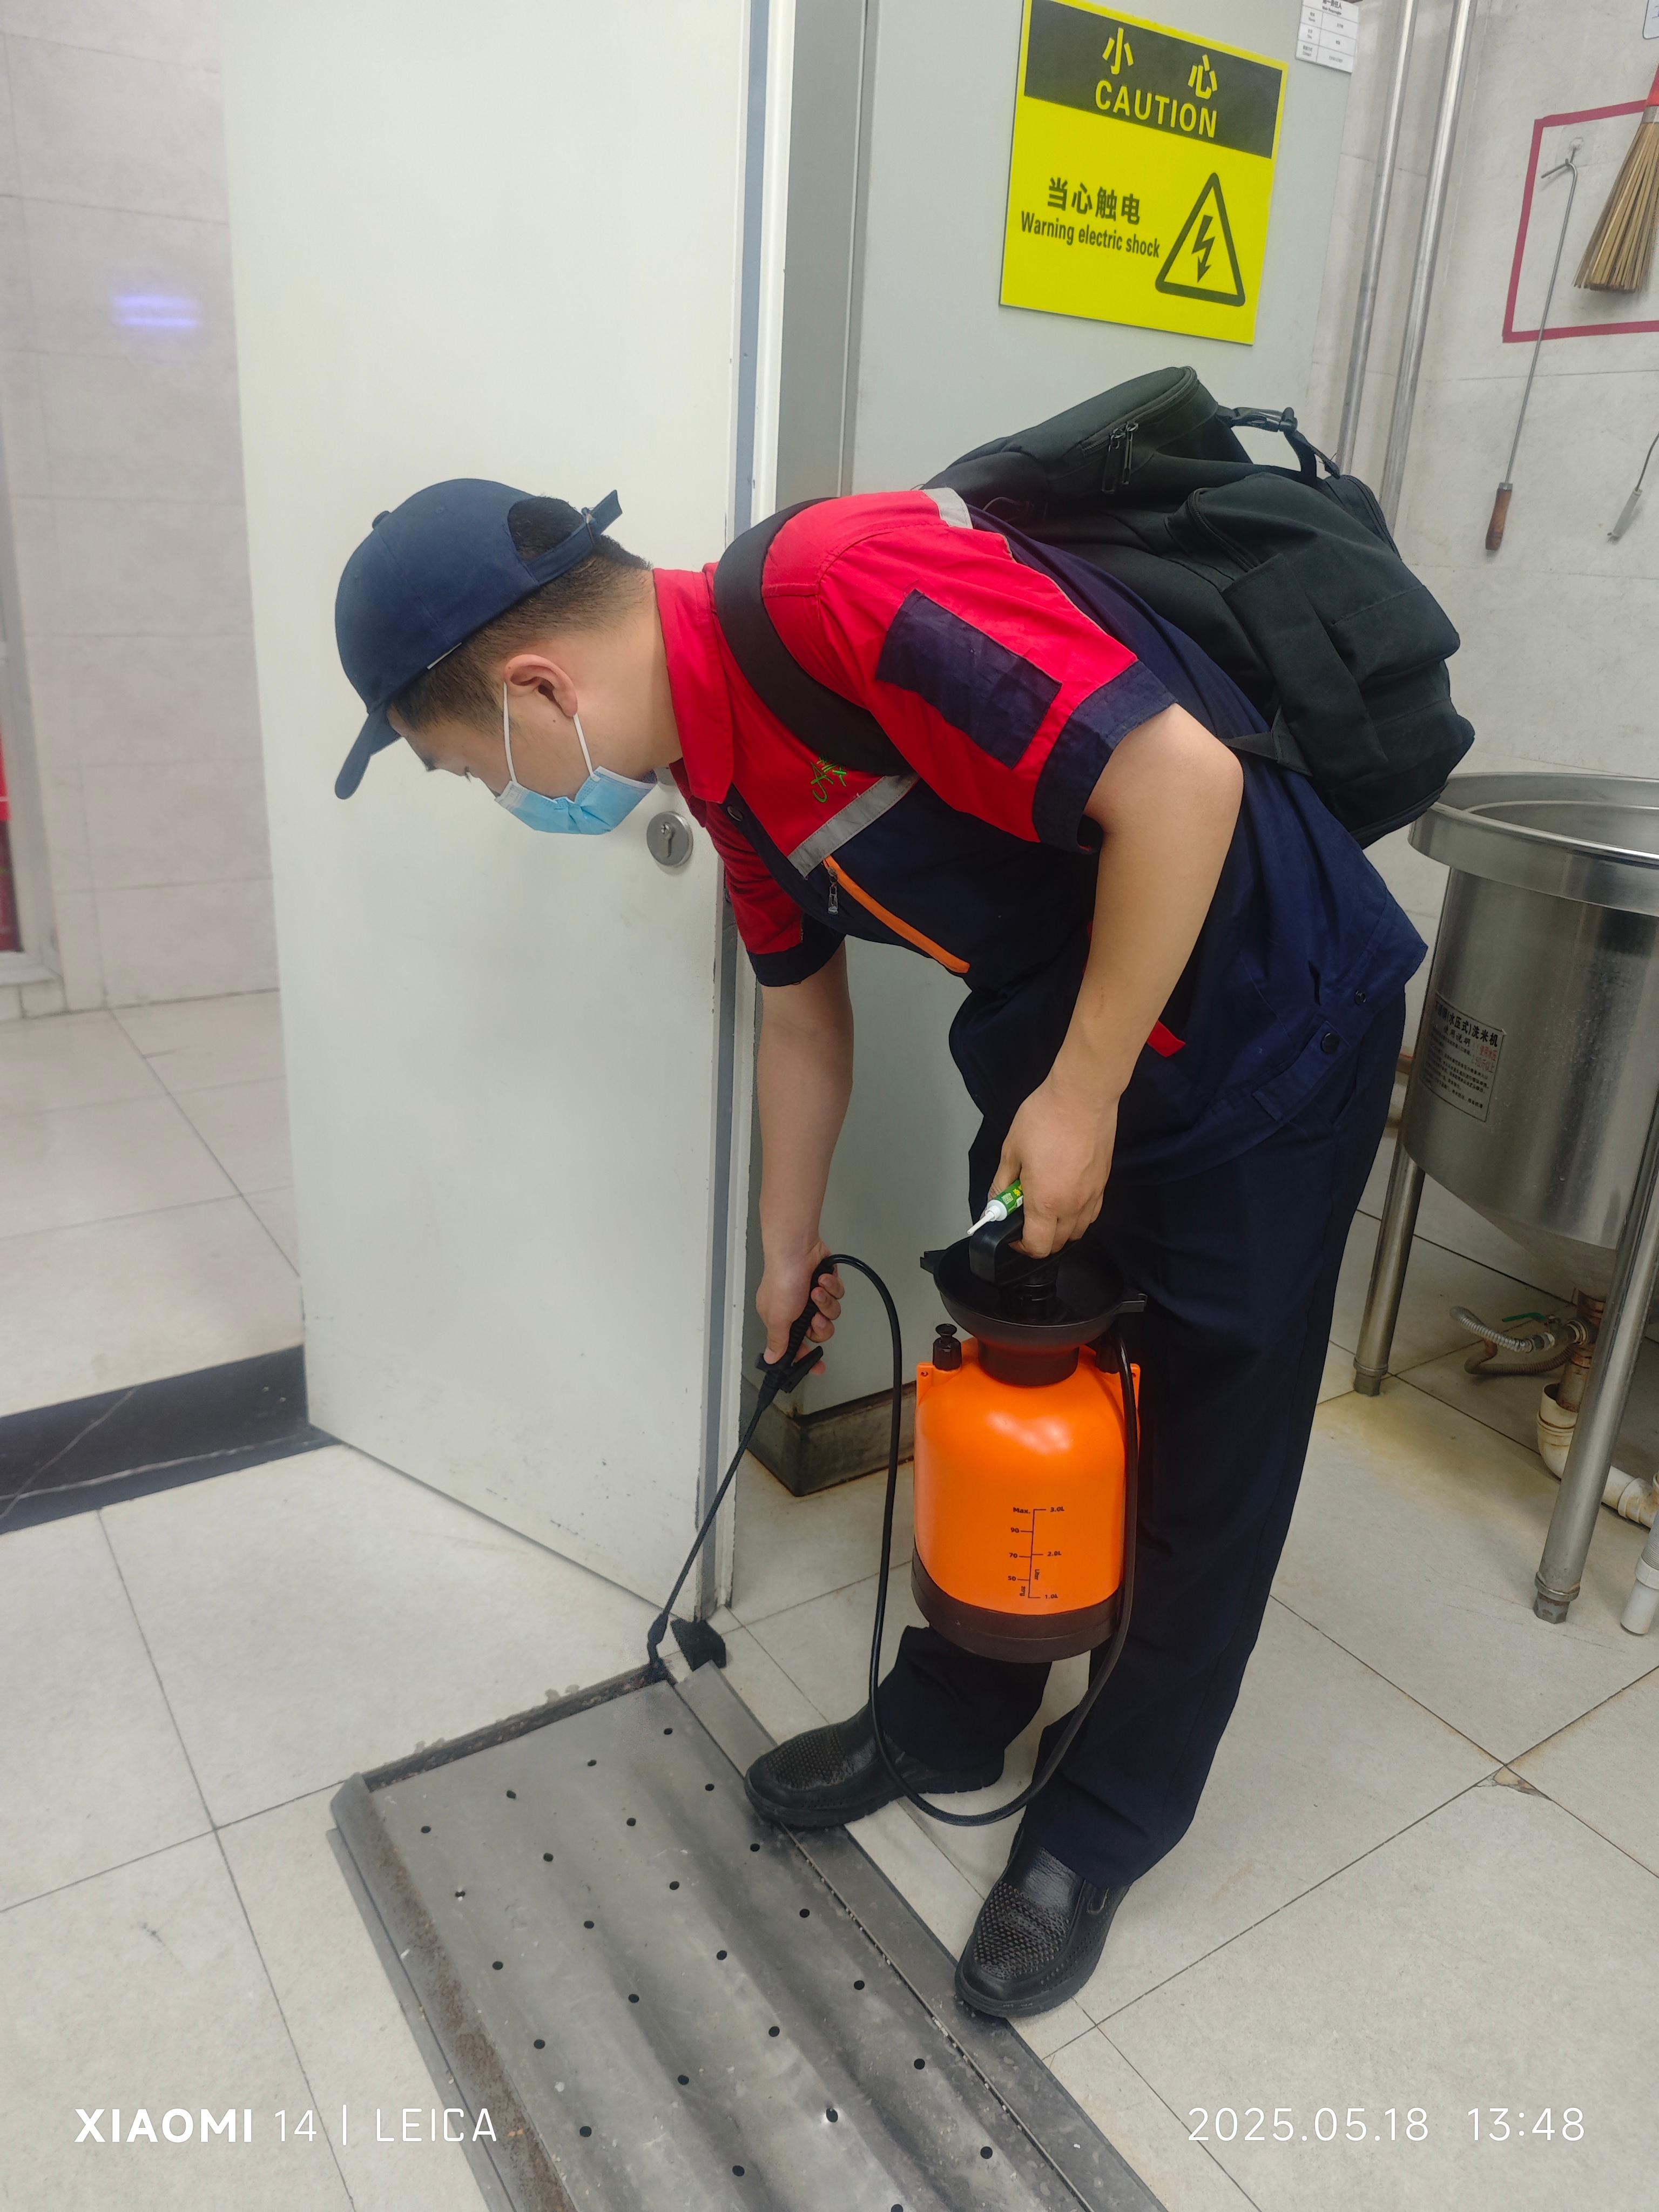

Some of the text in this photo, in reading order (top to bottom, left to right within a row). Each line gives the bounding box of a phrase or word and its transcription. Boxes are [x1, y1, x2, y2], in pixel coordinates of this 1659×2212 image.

[1102, 27, 1218, 99] 小 心
[1095, 79, 1217, 138] CAUTION
[1047, 177, 1141, 225] 当心触电
[1021, 210, 1161, 258] Warning electric shock
